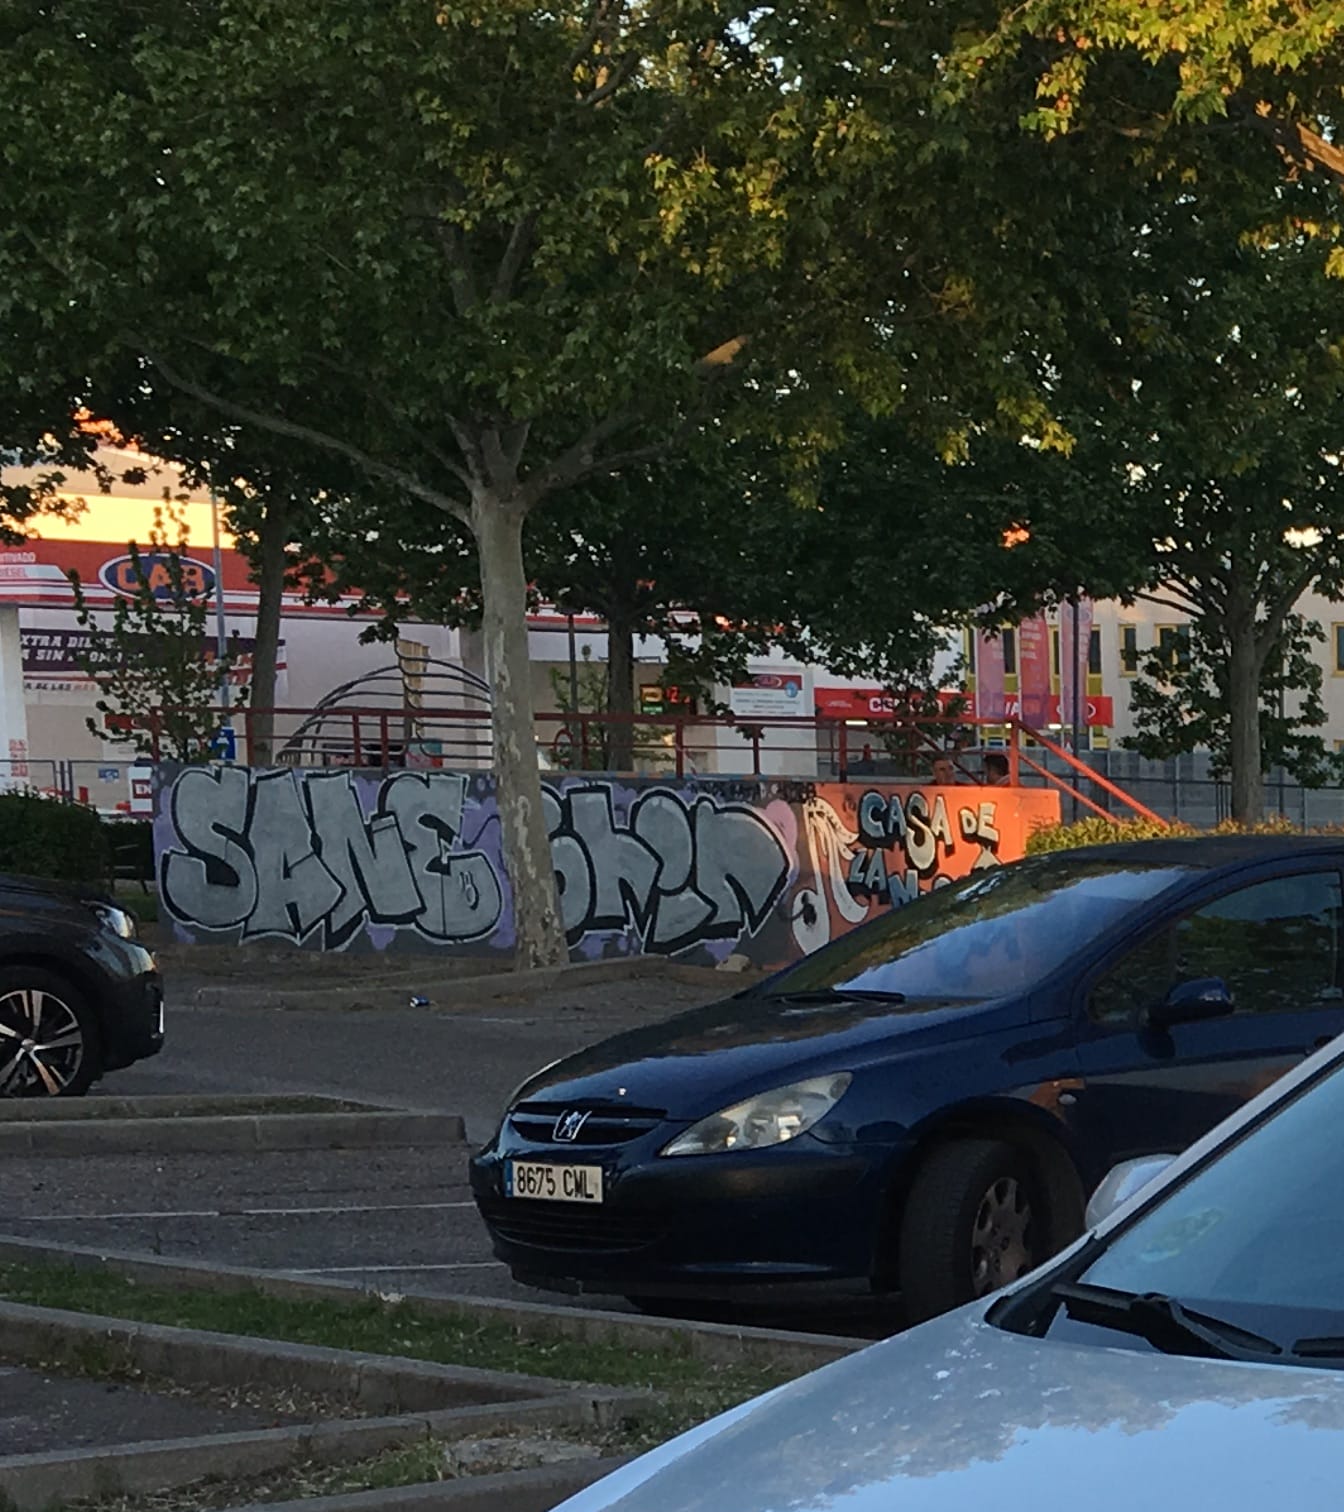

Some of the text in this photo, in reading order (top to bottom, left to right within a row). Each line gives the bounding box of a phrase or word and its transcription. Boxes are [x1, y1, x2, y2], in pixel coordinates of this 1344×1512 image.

[117, 562, 205, 592] CAB
[21, 635, 62, 647] XTRA
[859, 791, 999, 871] CASA DE
[160, 766, 502, 949] SANE
[850, 847, 889, 893] LA
[517, 1165, 594, 1199] 8675 CML
